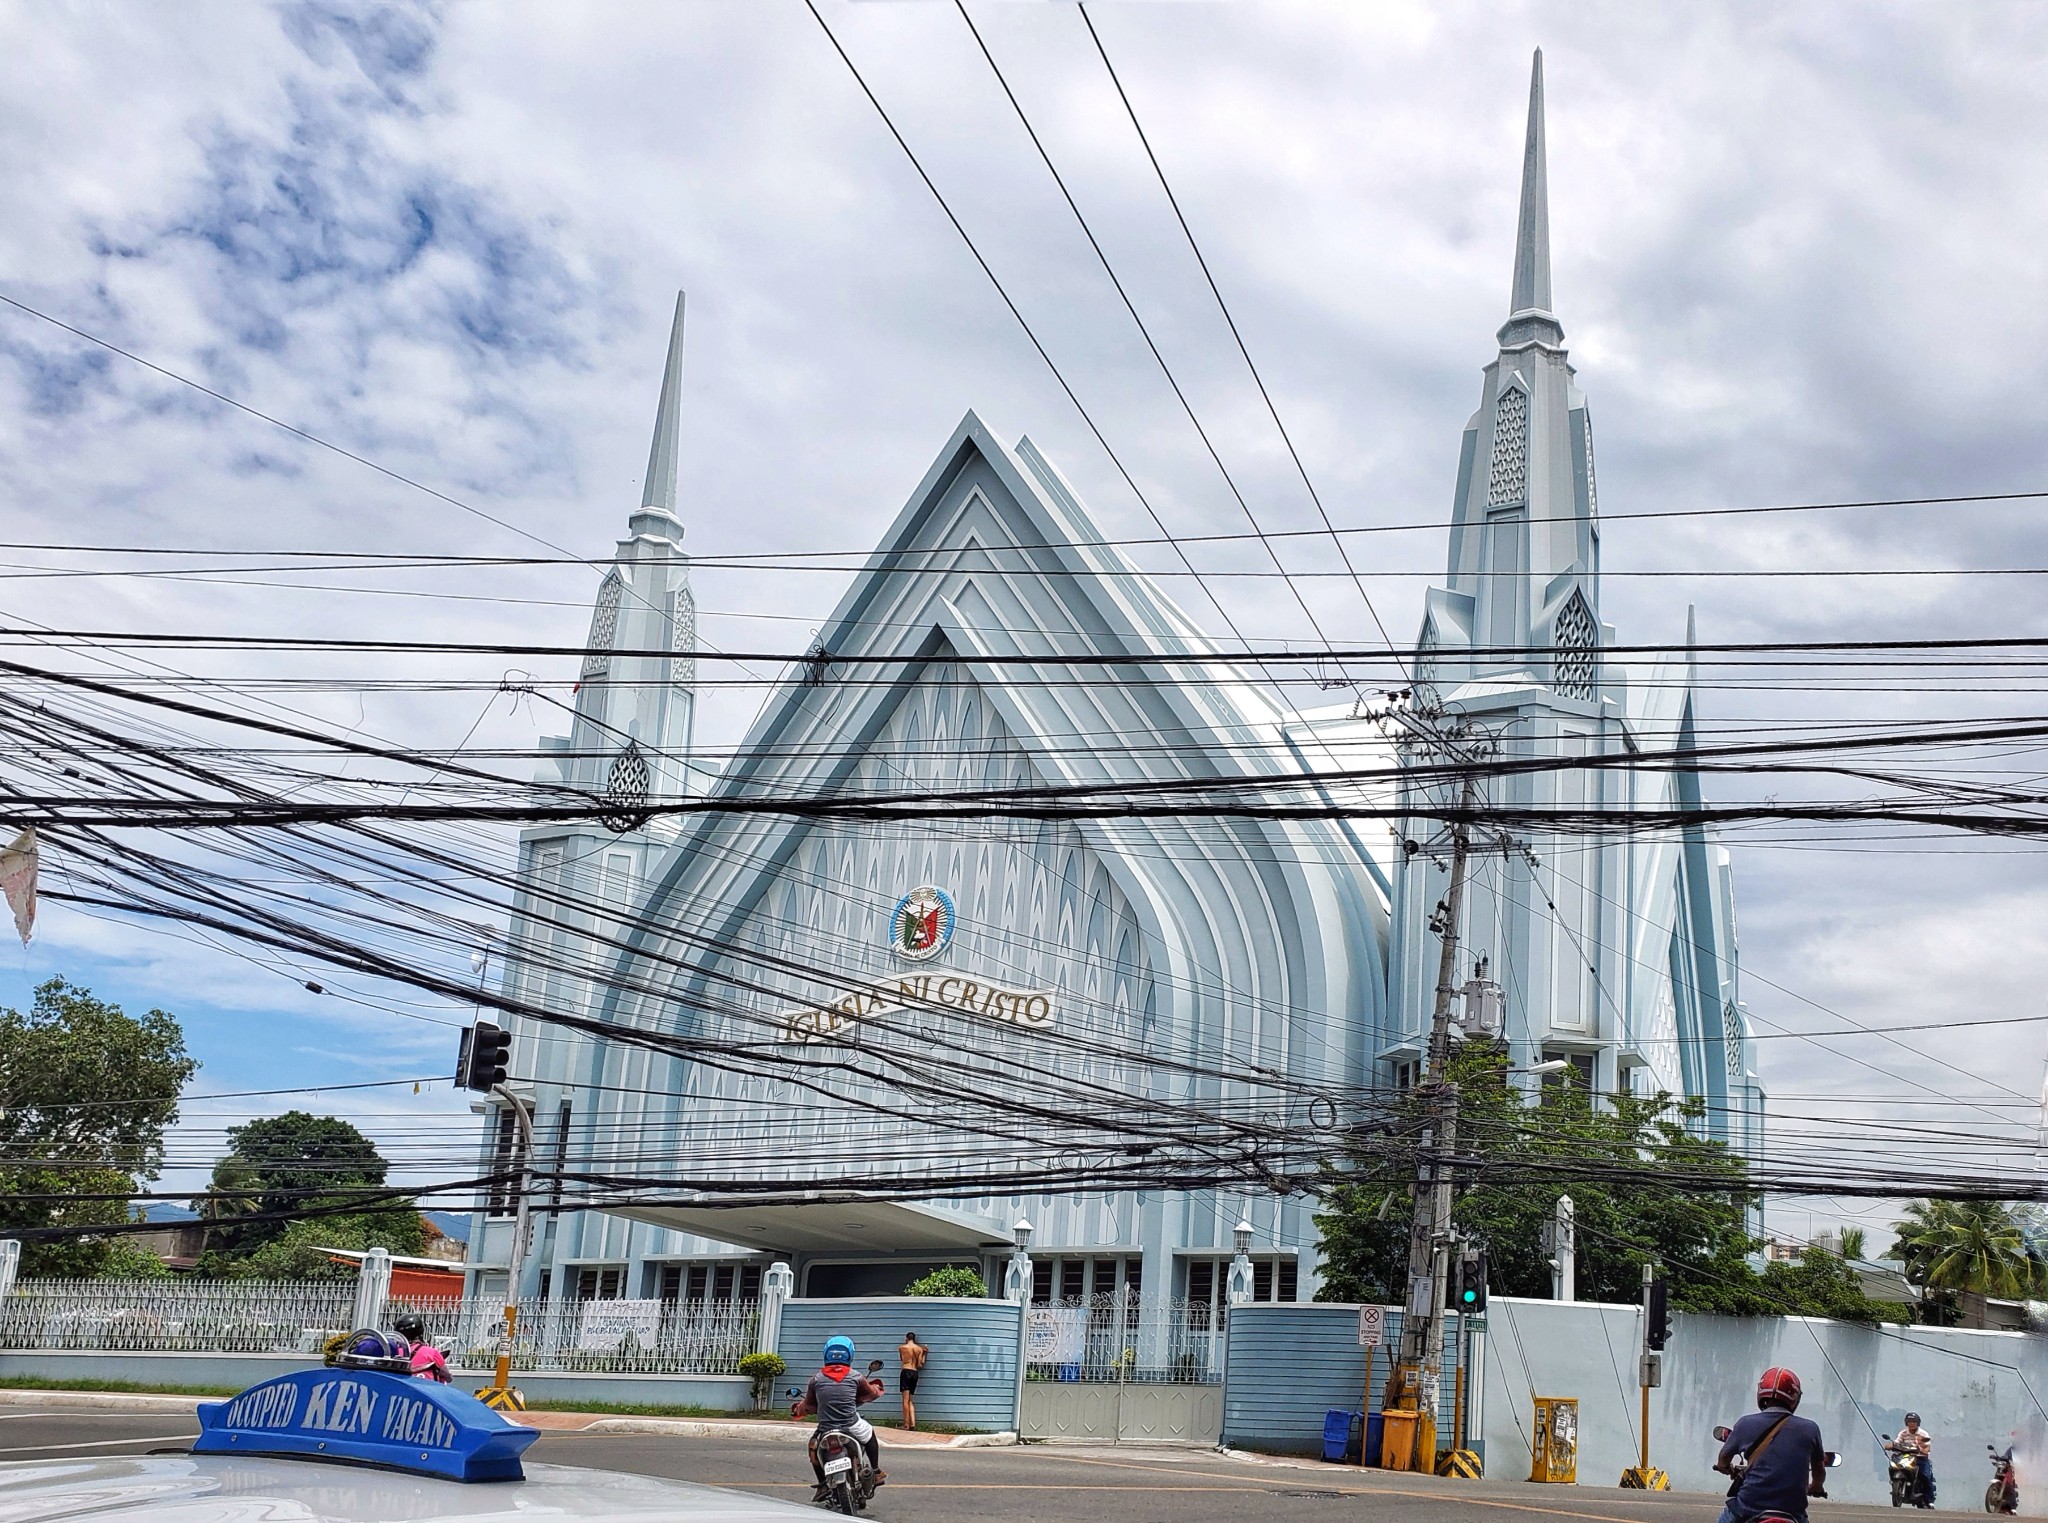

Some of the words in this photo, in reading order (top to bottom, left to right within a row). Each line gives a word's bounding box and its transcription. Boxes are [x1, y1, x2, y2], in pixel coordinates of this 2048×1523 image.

[784, 990, 887, 1041] IGLESIA
[900, 977, 931, 1004] NI
[938, 978, 1050, 1023] CRISTO
[226, 1382, 298, 1428] OCCUPIED
[300, 1380, 379, 1434] KEN
[382, 1395, 457, 1448] VACANT
